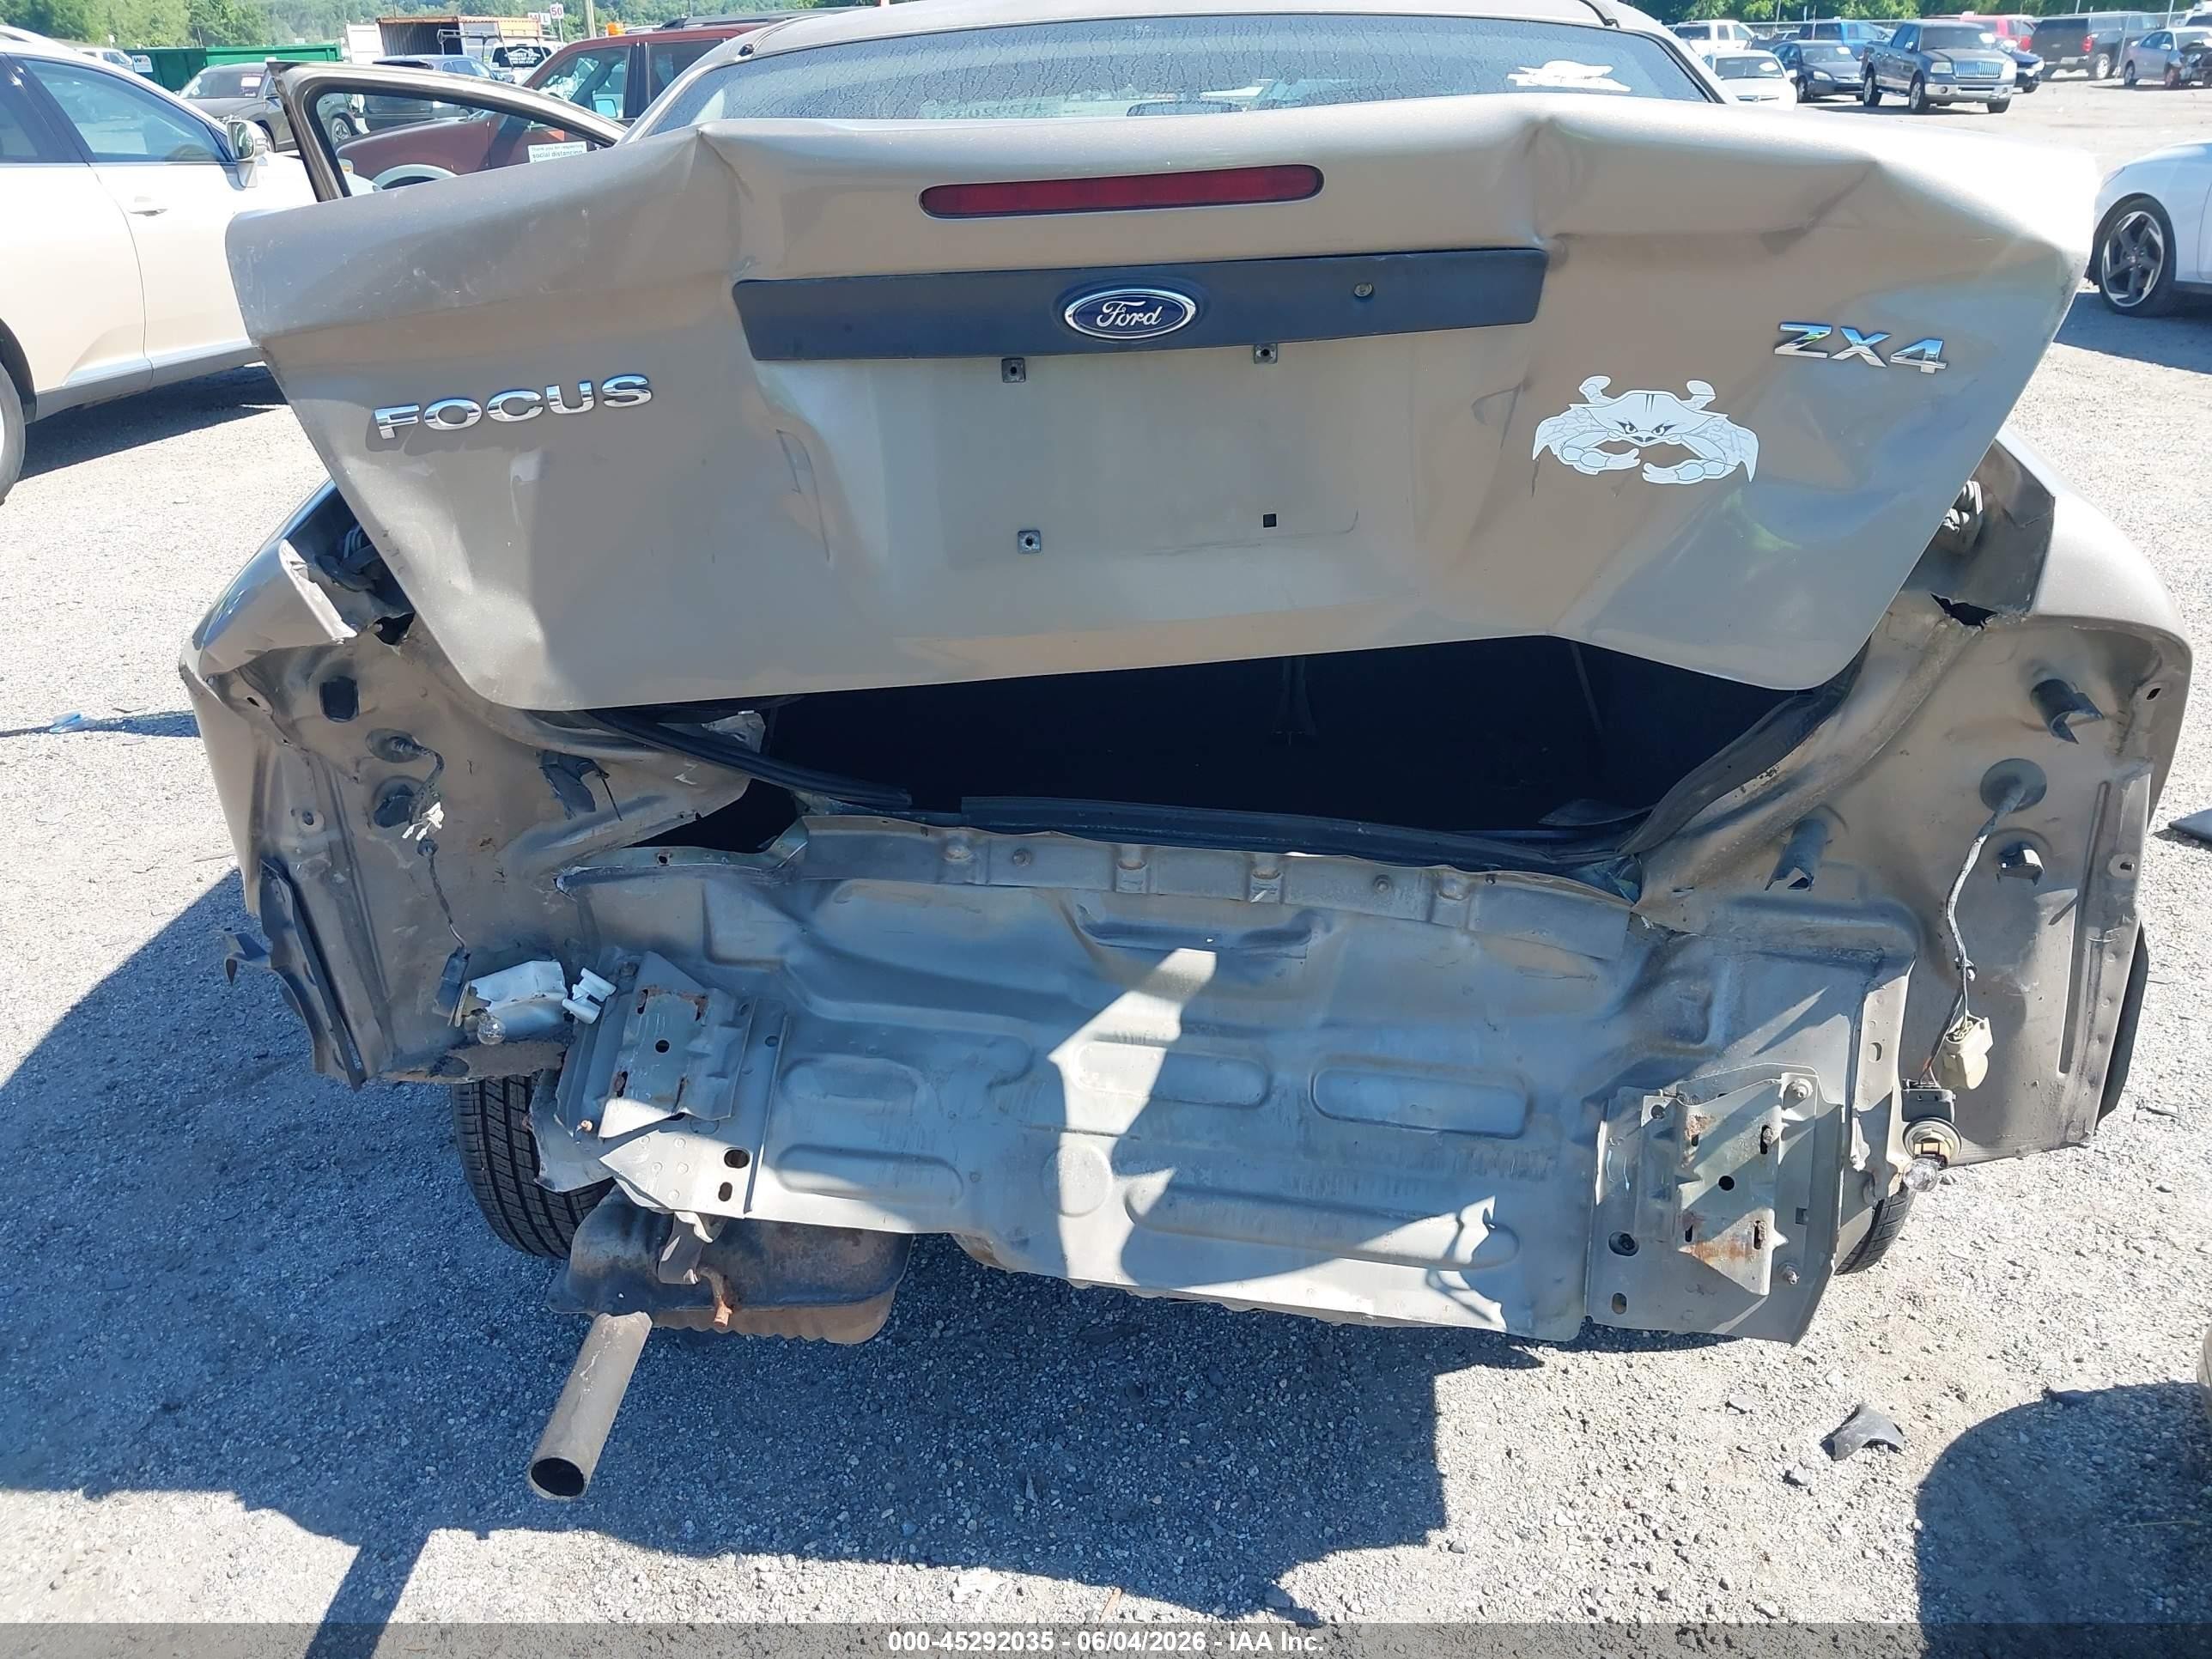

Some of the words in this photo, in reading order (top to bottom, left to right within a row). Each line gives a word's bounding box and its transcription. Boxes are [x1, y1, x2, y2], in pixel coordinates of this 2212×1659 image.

[551, 7, 562, 15] 50
[1096, 301, 1164, 327] Ford
[1773, 323, 1948, 374] ZX4
[374, 374, 653, 440] FOCUS
